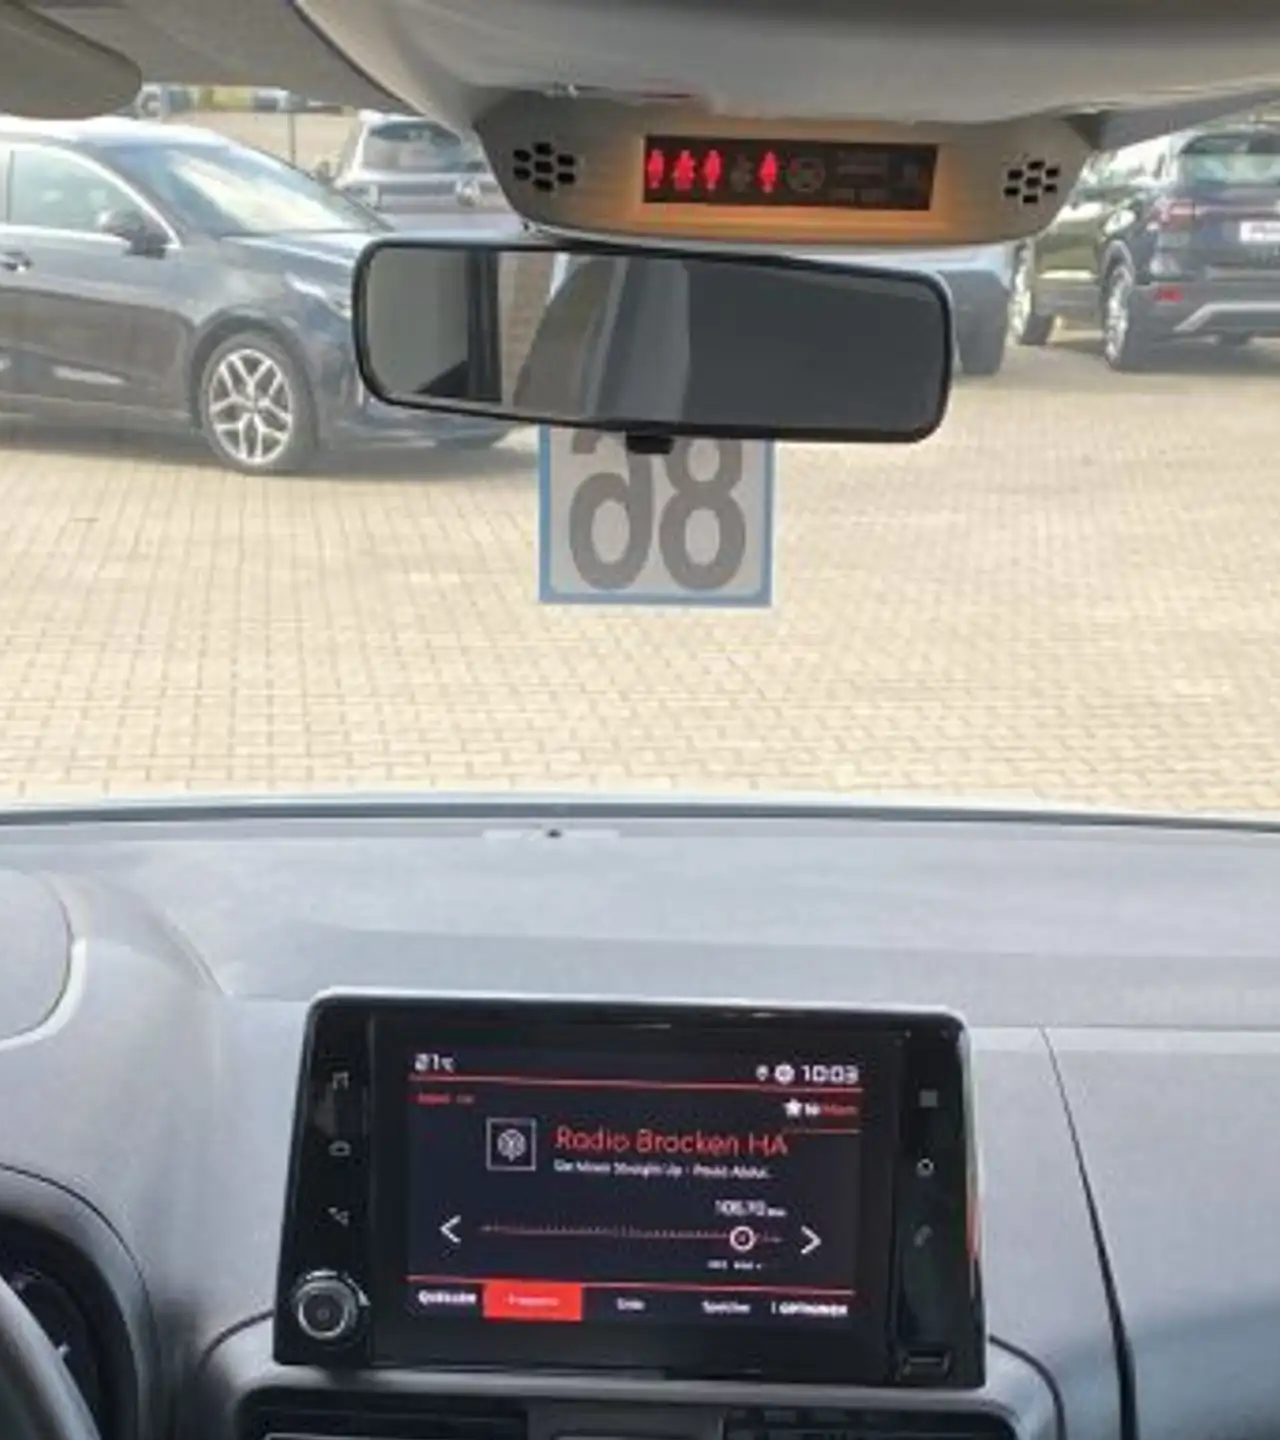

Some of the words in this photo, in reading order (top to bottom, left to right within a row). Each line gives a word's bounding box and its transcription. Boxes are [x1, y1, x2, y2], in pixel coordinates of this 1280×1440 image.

[801, 1064, 859, 1085] 10:03
[556, 1124, 630, 1153] Radio
[636, 1128, 739, 1156] Brocken
